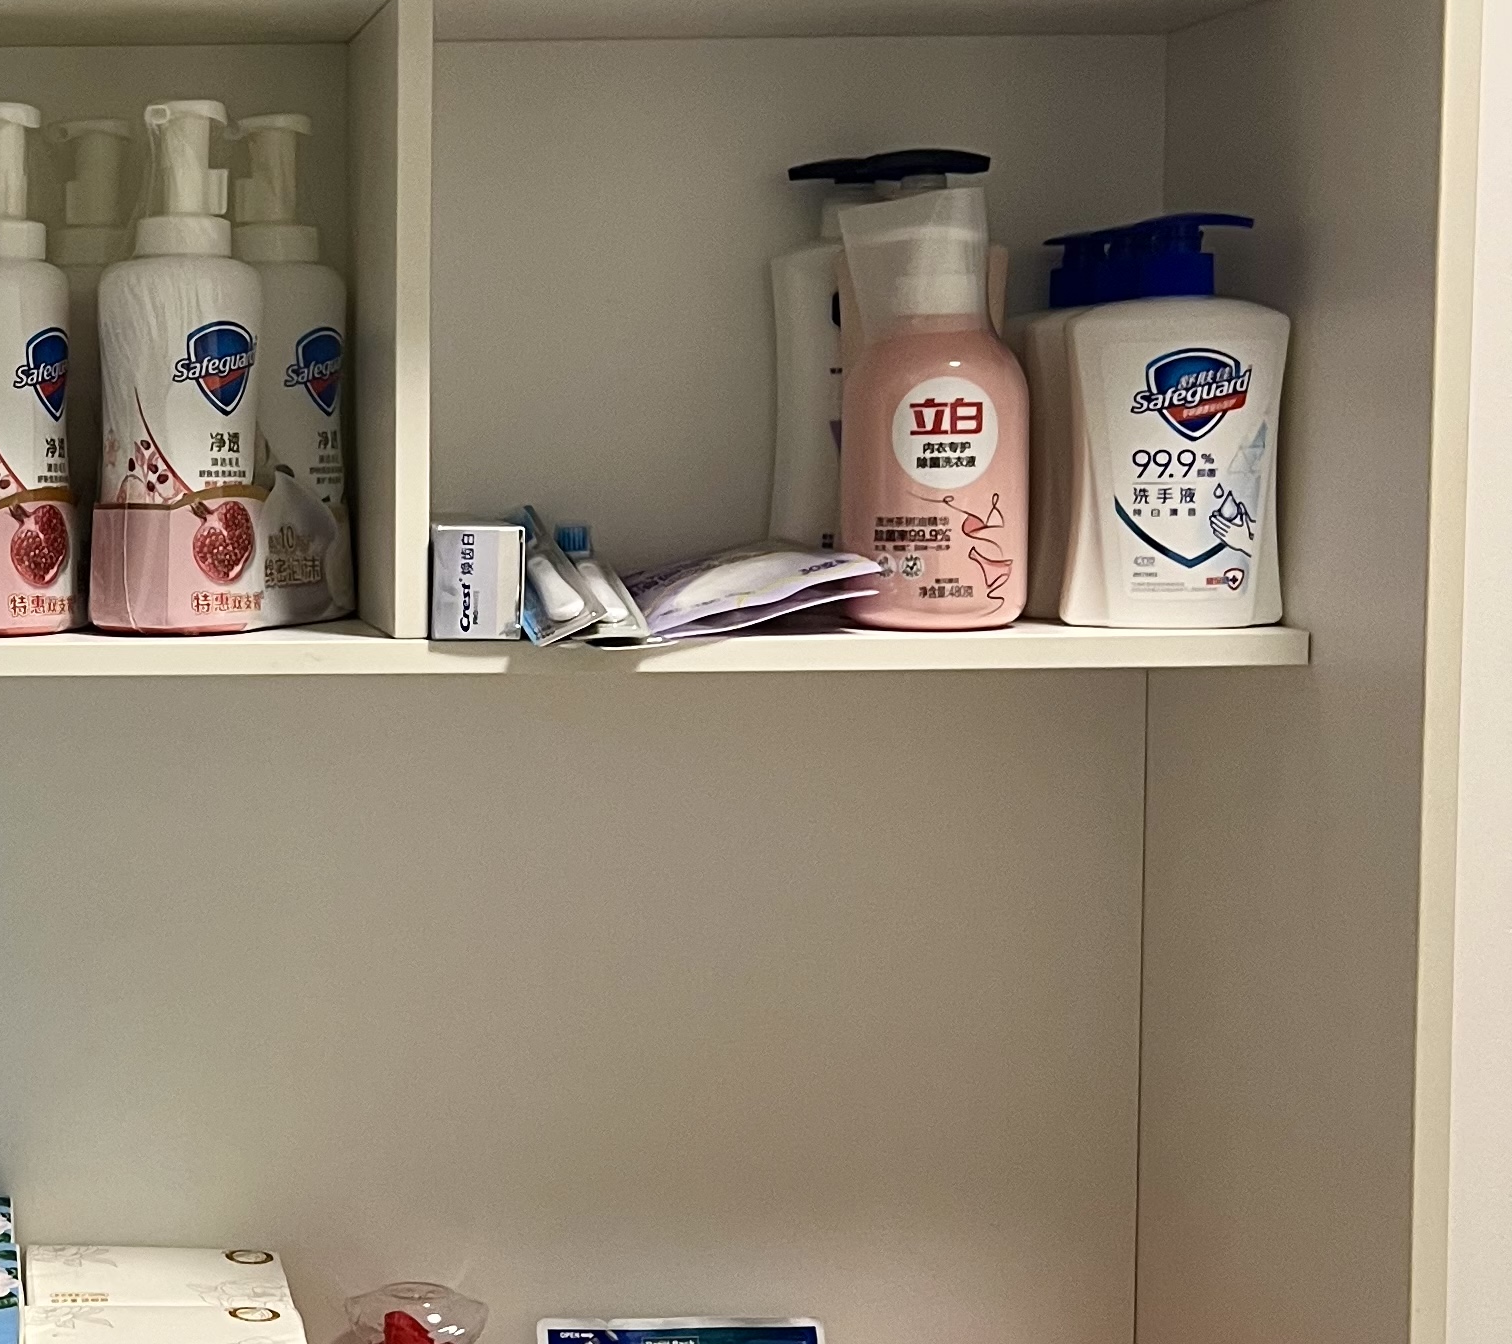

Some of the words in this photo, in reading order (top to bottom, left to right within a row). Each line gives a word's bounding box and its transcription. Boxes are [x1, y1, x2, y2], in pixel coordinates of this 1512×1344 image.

[1131, 368, 1251, 414] Safeguard
[908, 397, 984, 436] 立白
[209, 431, 241, 454] 净透
[1132, 487, 1197, 505] 洗手液
[459, 581, 471, 633] Crest
